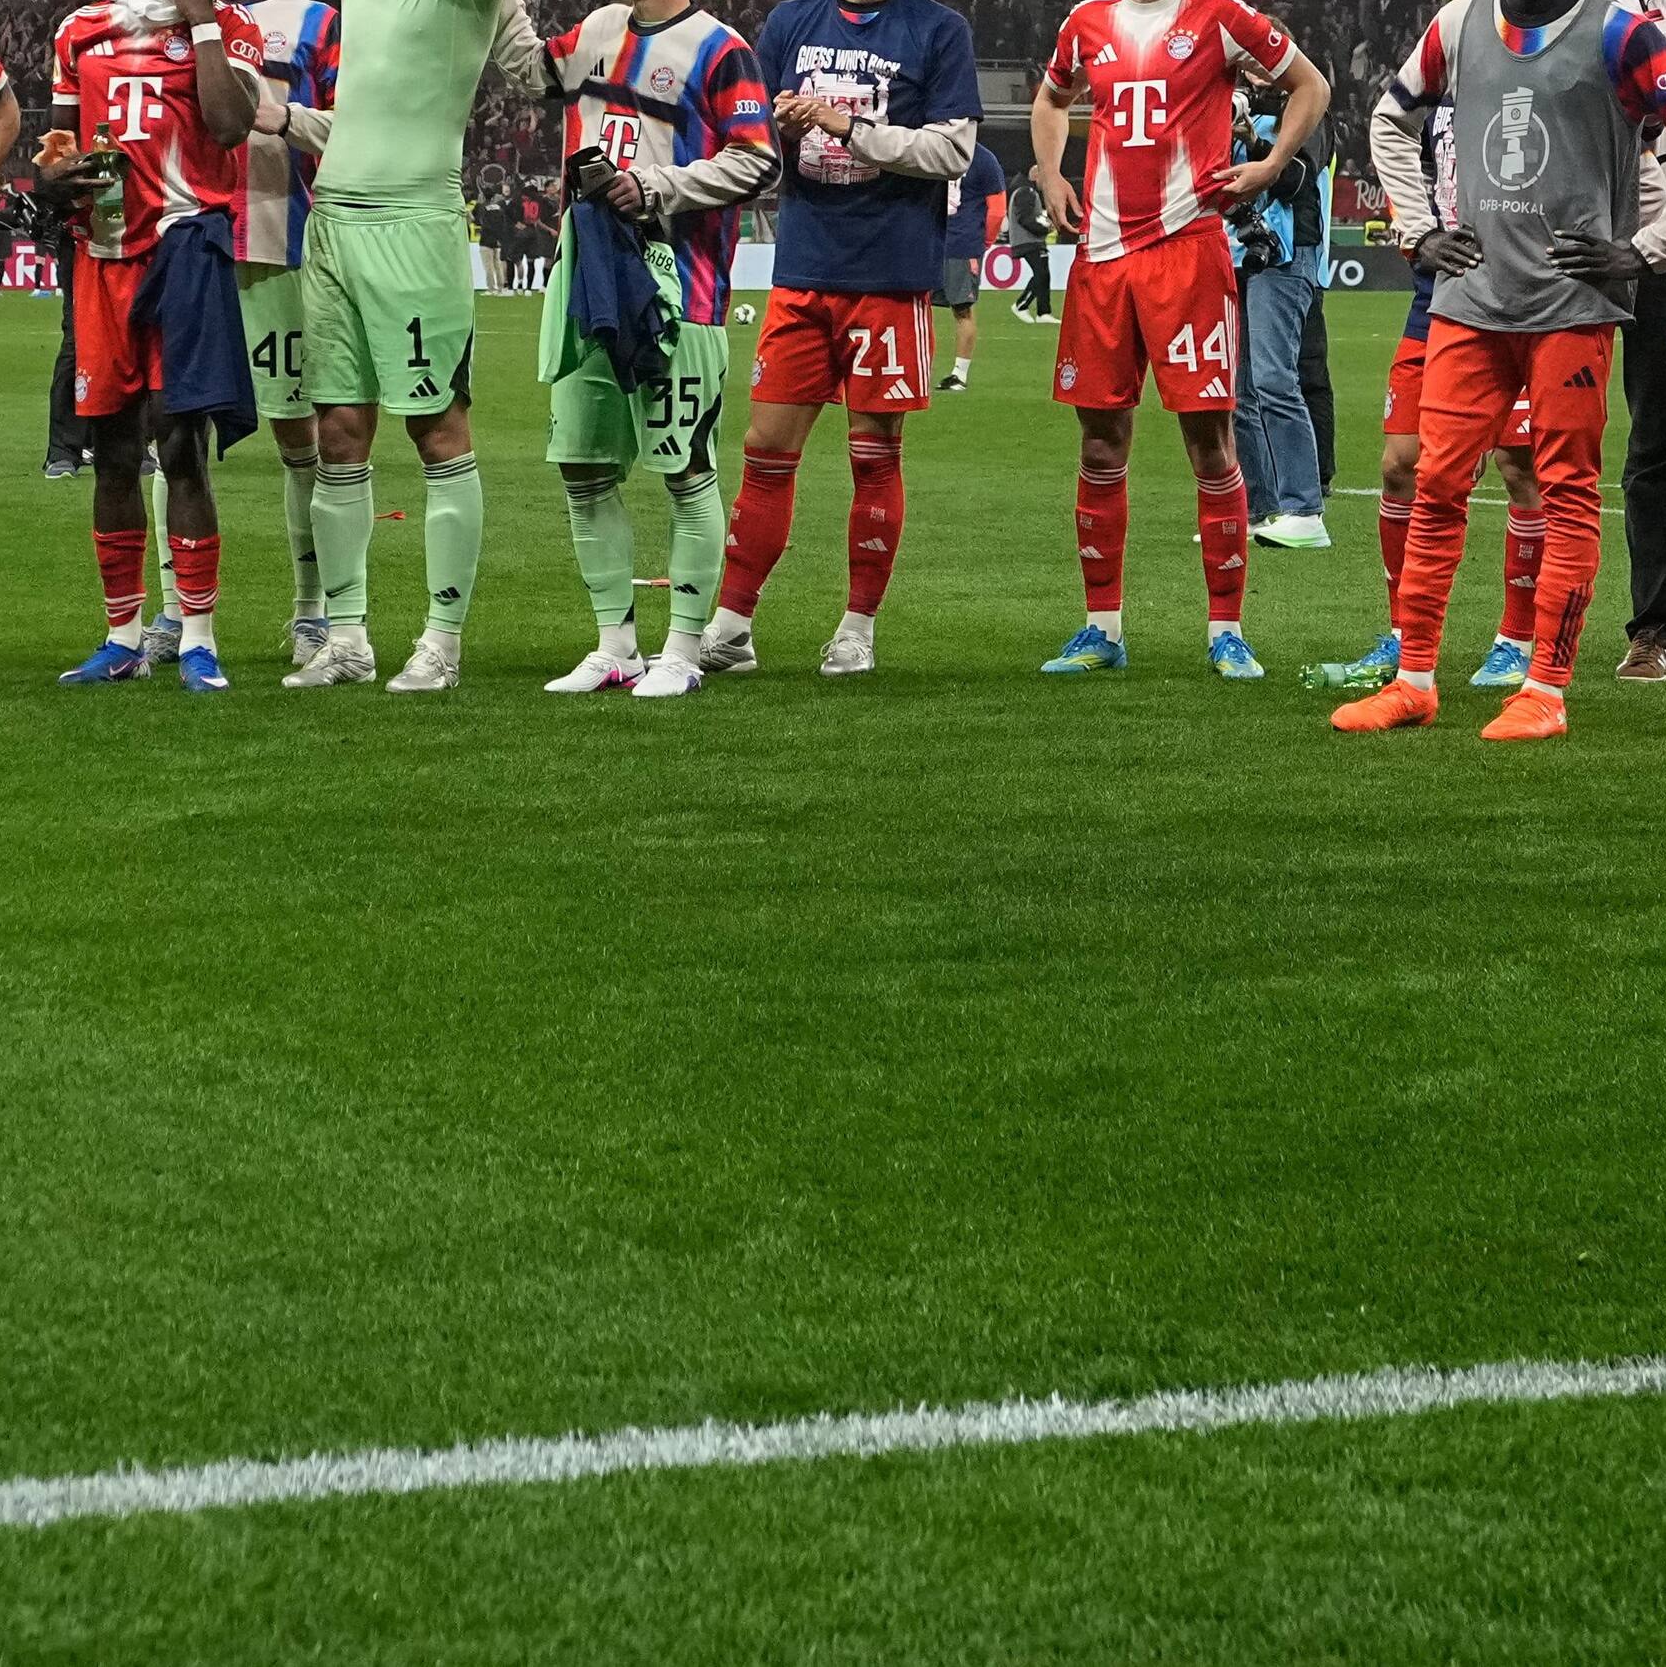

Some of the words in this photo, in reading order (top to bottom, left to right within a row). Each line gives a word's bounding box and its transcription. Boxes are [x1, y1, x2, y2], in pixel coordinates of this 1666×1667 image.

[795, 44, 835, 75] GUESS
[835, 49, 868, 72] WHO'S
[867, 53, 901, 80] BACK
[1480, 199, 1546, 216] DFB-POKAL
[406, 316, 431, 368] 1
[848, 326, 905, 377] 21
[1168, 321, 1231, 375] 44
[646, 376, 703, 429] 35
